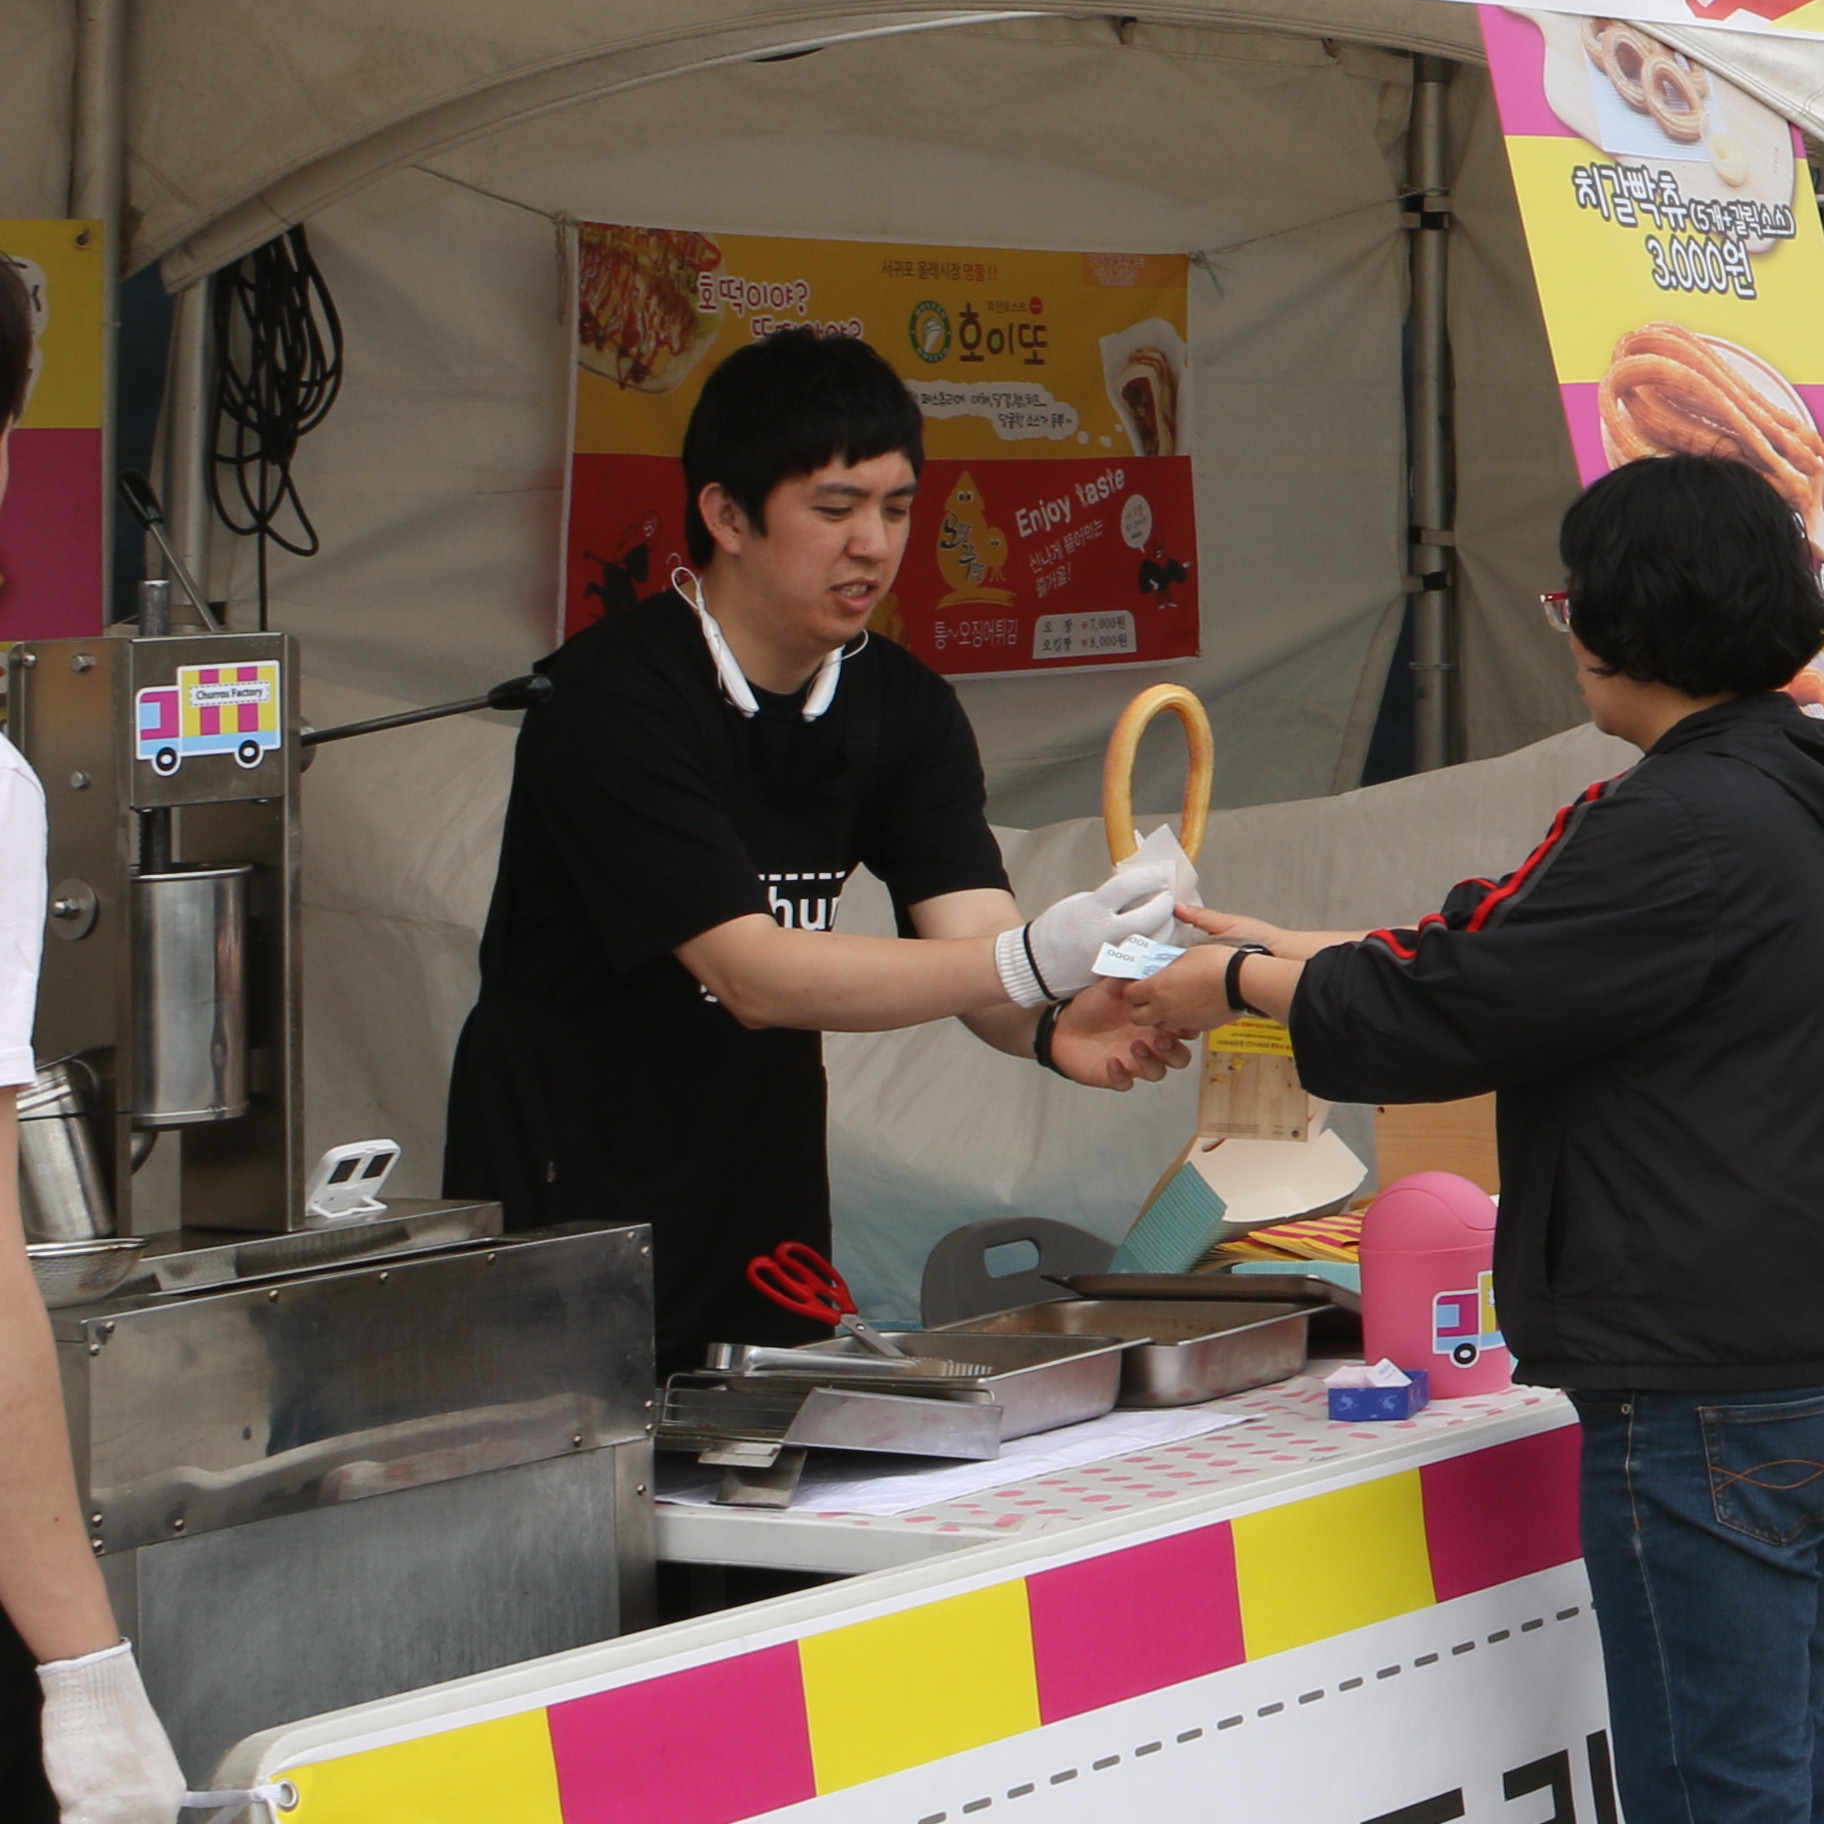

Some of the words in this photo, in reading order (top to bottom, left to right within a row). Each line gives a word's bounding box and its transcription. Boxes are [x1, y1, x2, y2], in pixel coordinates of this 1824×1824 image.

[695, 272, 811, 319] 호떡이야?
[958, 301, 1048, 367] 호이또
[1014, 494, 1072, 539] Enjoy
[1074, 467, 1126, 509] taste
[195, 686, 231, 702] Churros
[231, 685, 265, 701] Factory
